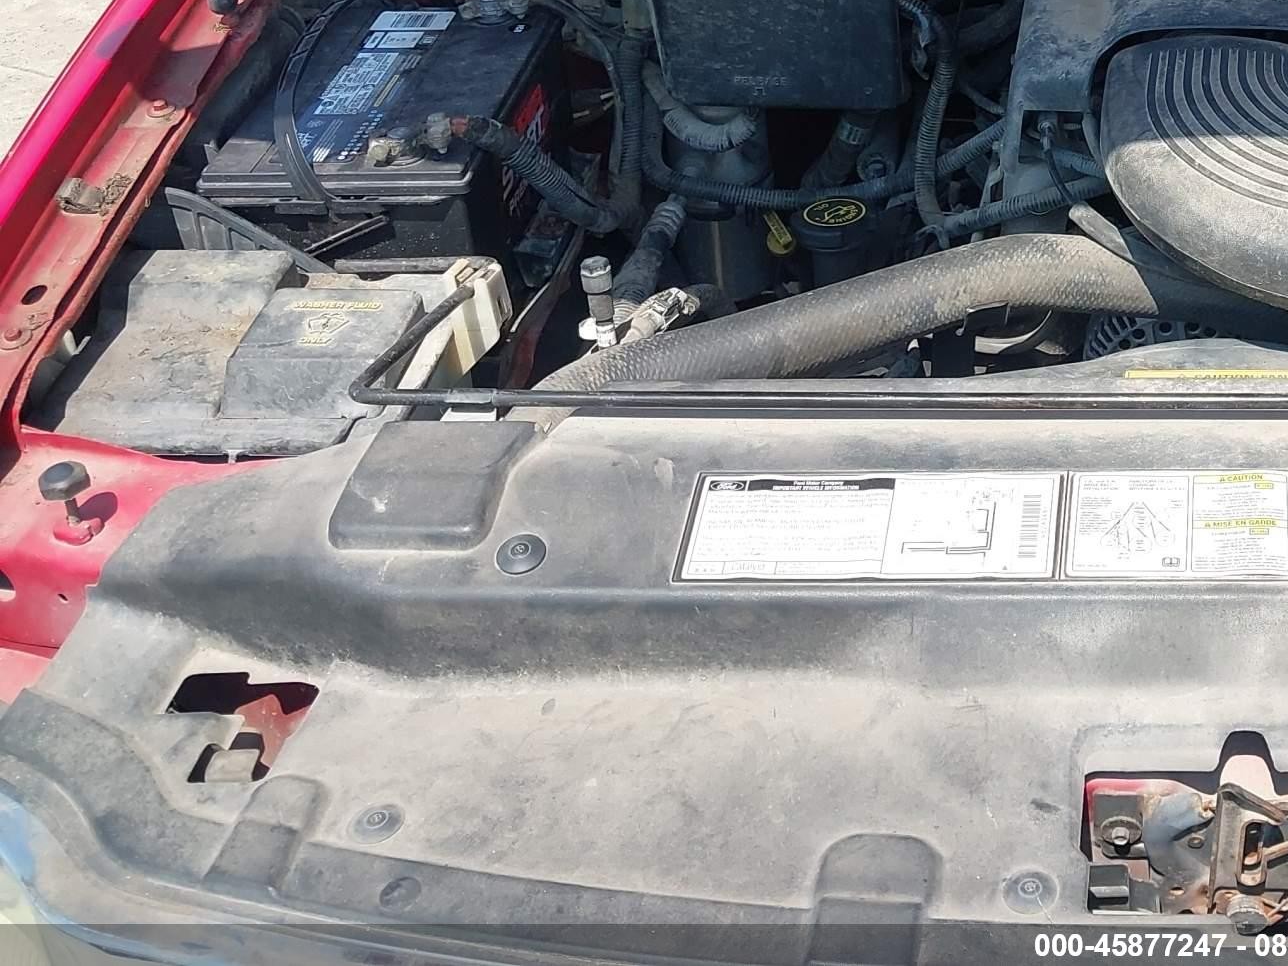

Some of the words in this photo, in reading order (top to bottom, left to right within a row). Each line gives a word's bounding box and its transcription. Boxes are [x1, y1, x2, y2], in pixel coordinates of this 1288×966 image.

[294, 301, 345, 309] WASHER
[348, 301, 383, 310] FLUID
[1227, 474, 1263, 482] CAUTION
